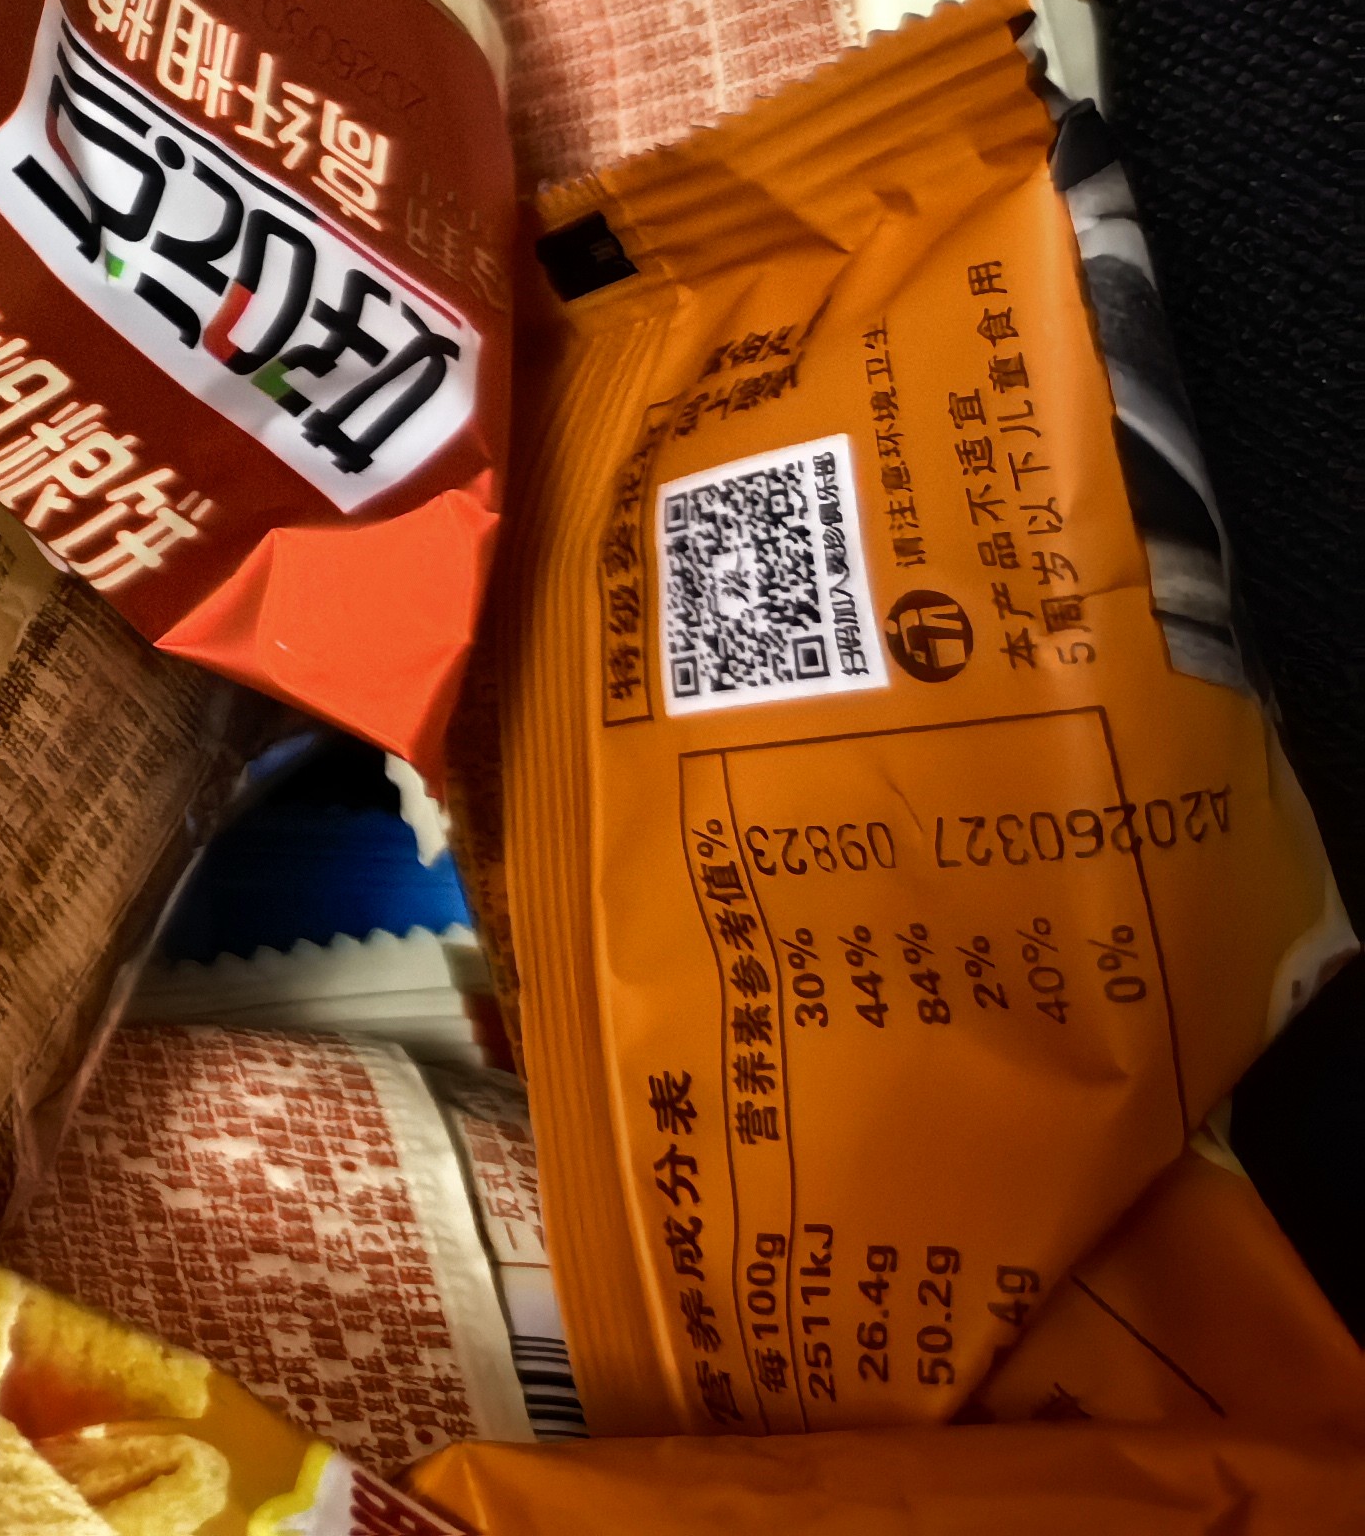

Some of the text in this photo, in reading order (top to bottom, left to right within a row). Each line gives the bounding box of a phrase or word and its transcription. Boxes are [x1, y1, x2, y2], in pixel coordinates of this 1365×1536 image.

[14, 20, 464, 474] 好吃点
[967, 260, 1097, 668] 5周岁以下儿童食用
[947, 389, 1042, 671] 本产品不适宜
[744, 821, 896, 877] 09823
[788, 927, 831, 1030] 30%
[838, 924, 889, 1030] 44%
[895, 921, 951, 1026] 84%
[955, 935, 1009, 1012] 2%
[1018, 917, 1068, 1026] 40%
[1087, 924, 1145, 1004] 0%
[743, 1232, 790, 1395] 每100g
[801, 1222, 838, 1404] 2511kJ
[857, 1244, 899, 1385] 26.4g
[916, 1245, 962, 1387] 50.2g
